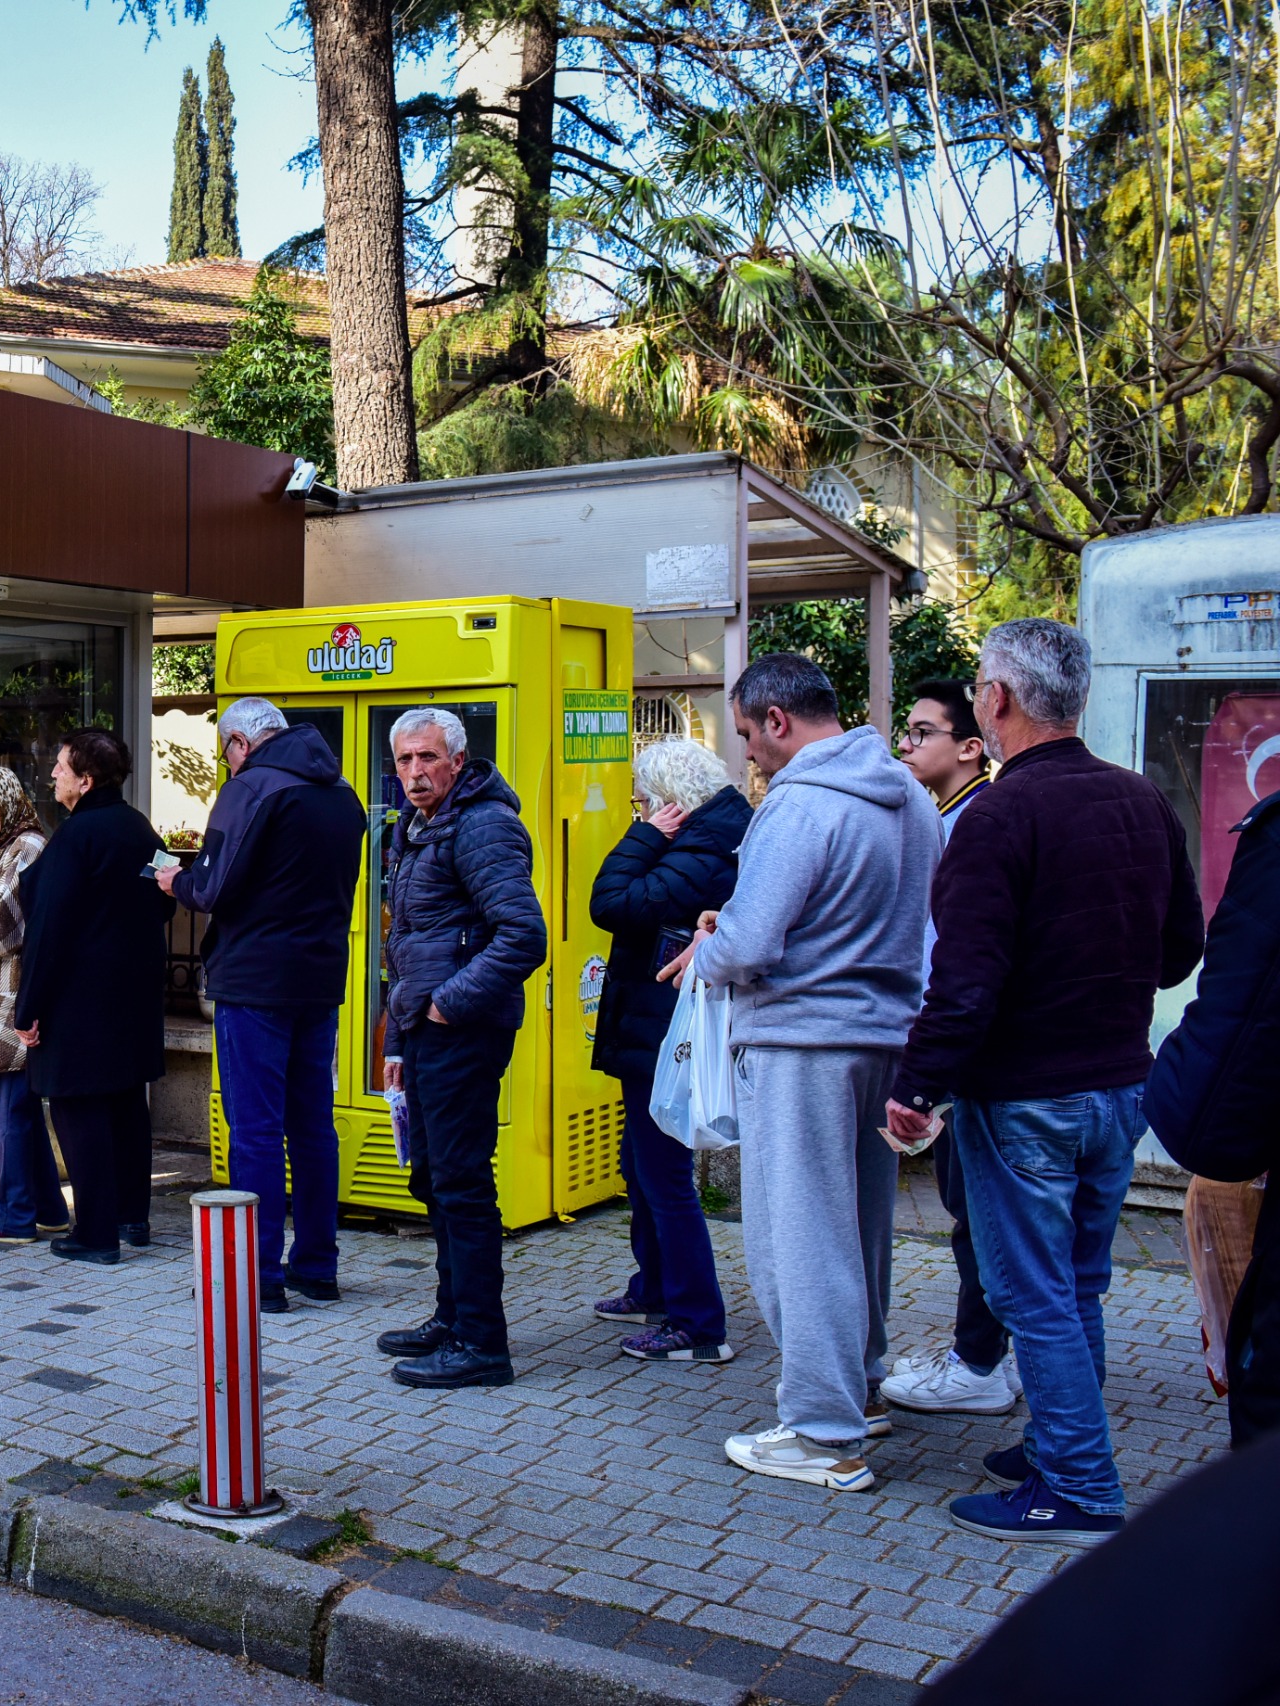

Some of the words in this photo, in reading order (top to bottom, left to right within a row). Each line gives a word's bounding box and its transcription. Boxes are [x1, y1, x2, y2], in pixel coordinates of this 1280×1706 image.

[307, 637, 394, 675] uludağ
[564, 712, 574, 733] EV
[575, 712, 600, 733] YAPIMI
[601, 712, 628, 733] TADINDA
